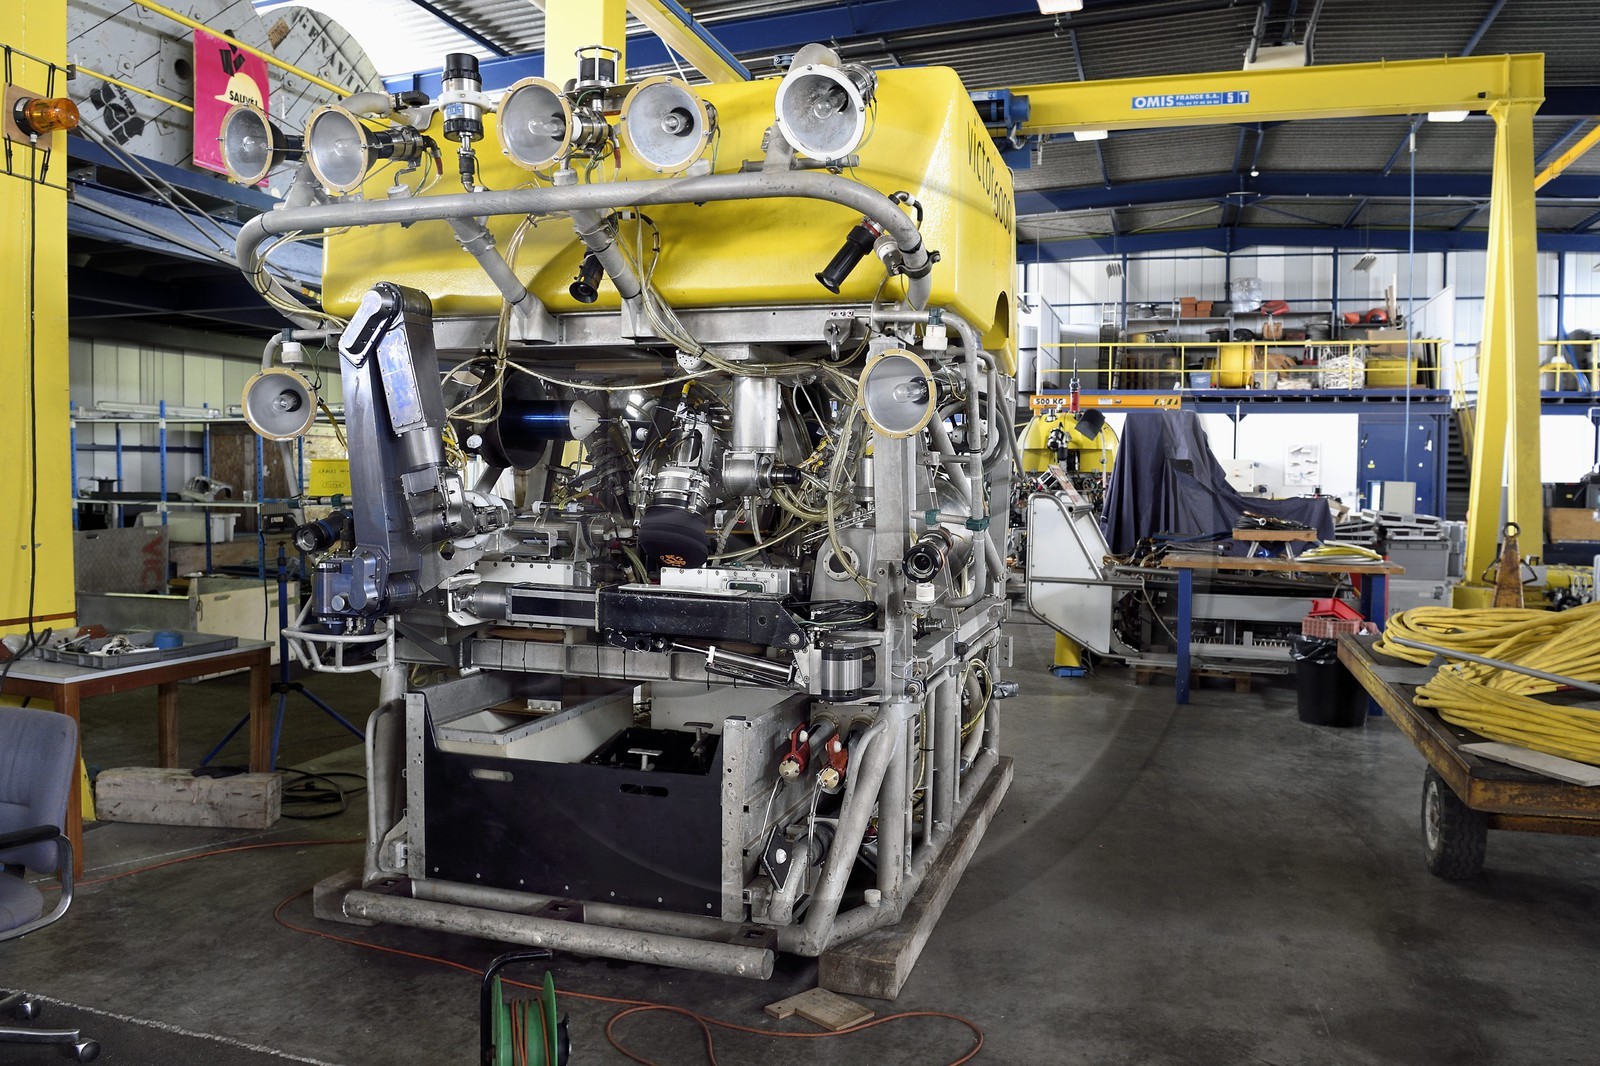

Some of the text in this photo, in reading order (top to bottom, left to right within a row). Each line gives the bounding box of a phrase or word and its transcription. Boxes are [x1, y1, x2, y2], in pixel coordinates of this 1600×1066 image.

[1134, 96, 1174, 108] OMIS
[1227, 92, 1234, 103] 5
[1240, 91, 1248, 103] T
